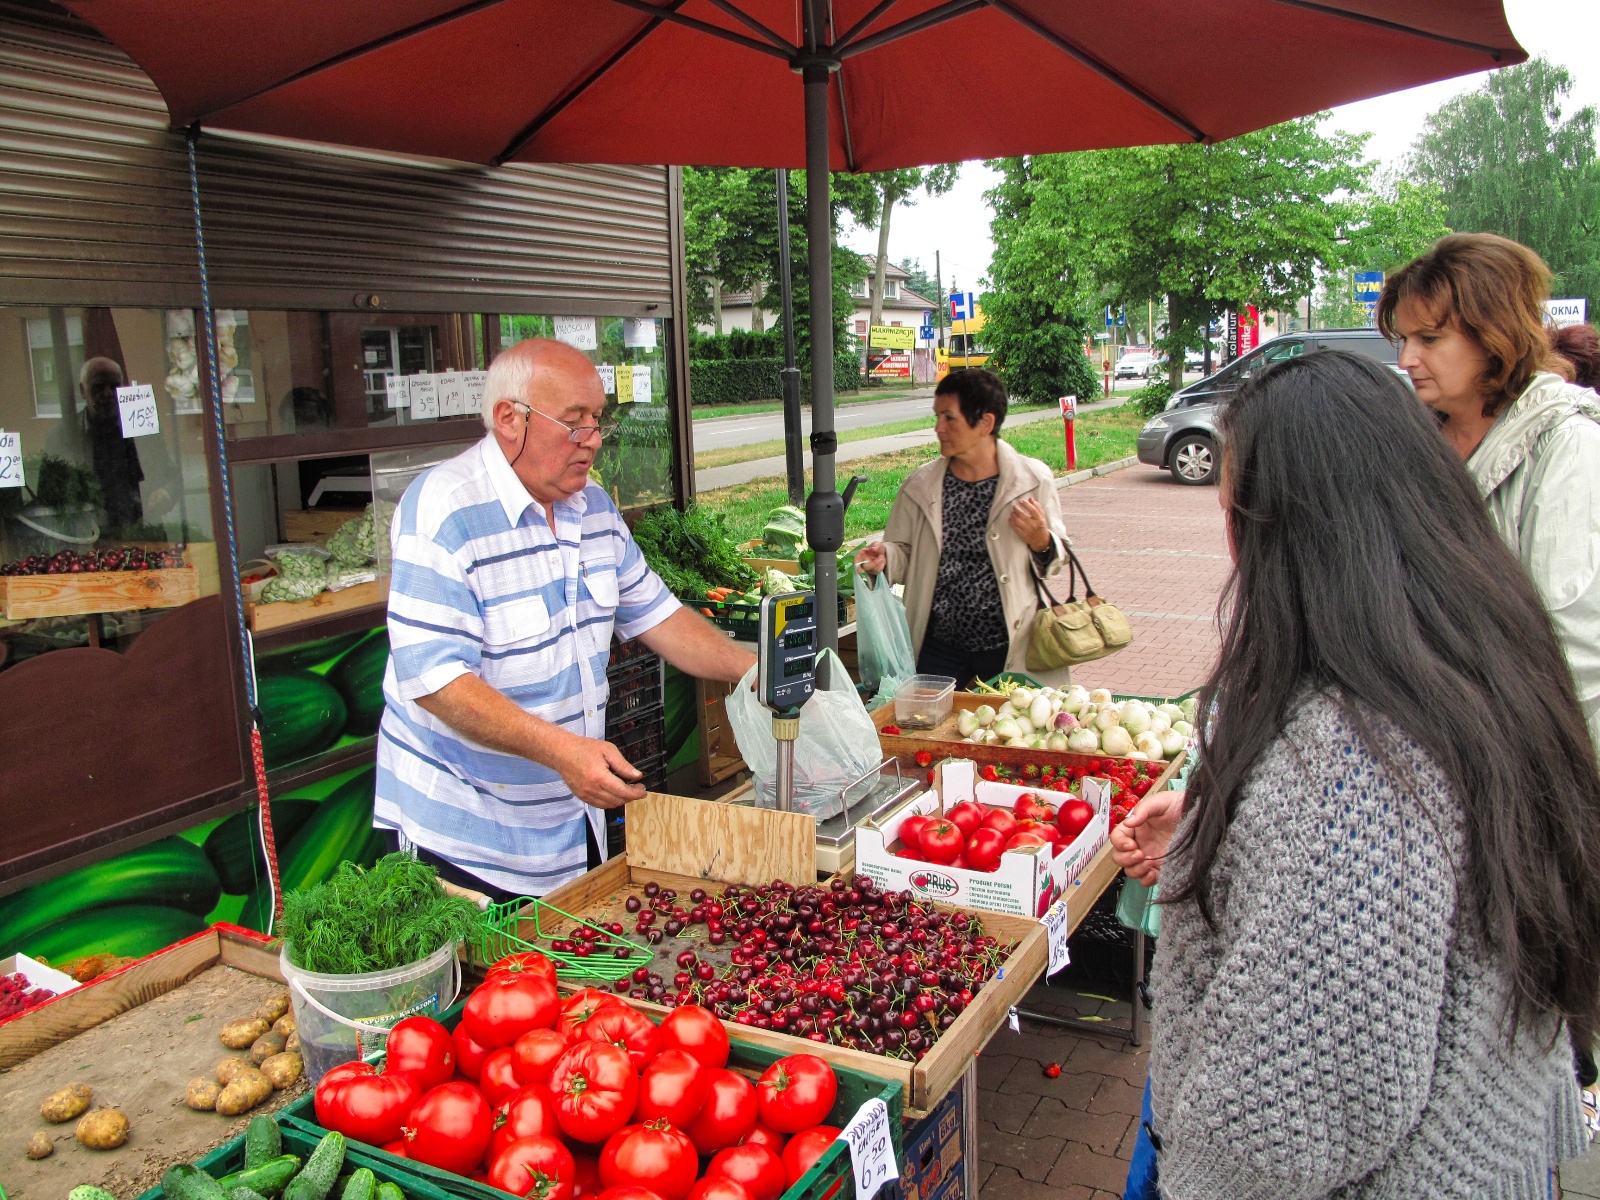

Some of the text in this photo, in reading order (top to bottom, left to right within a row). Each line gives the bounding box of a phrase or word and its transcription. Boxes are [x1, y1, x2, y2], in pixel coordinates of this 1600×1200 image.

[1356, 281, 1381, 293] WM
[1551, 305, 1580, 316] OKNA
[871, 327, 914, 337] WULKANIZACJA
[1240, 325, 1251, 356] Afrika
[118, 389, 152, 404] CZEREŚNIA
[0, 435, 14, 448] ÓB
[926, 872, 952, 892] PRUS
[968, 877, 1013, 890] Produkt Polski
[356, 996, 437, 1025] KAPUSTA KWASZONA
[846, 1102, 886, 1147] POMIDOR
[861, 1136, 886, 1190] 6 50
[876, 1163, 887, 1177] kg
